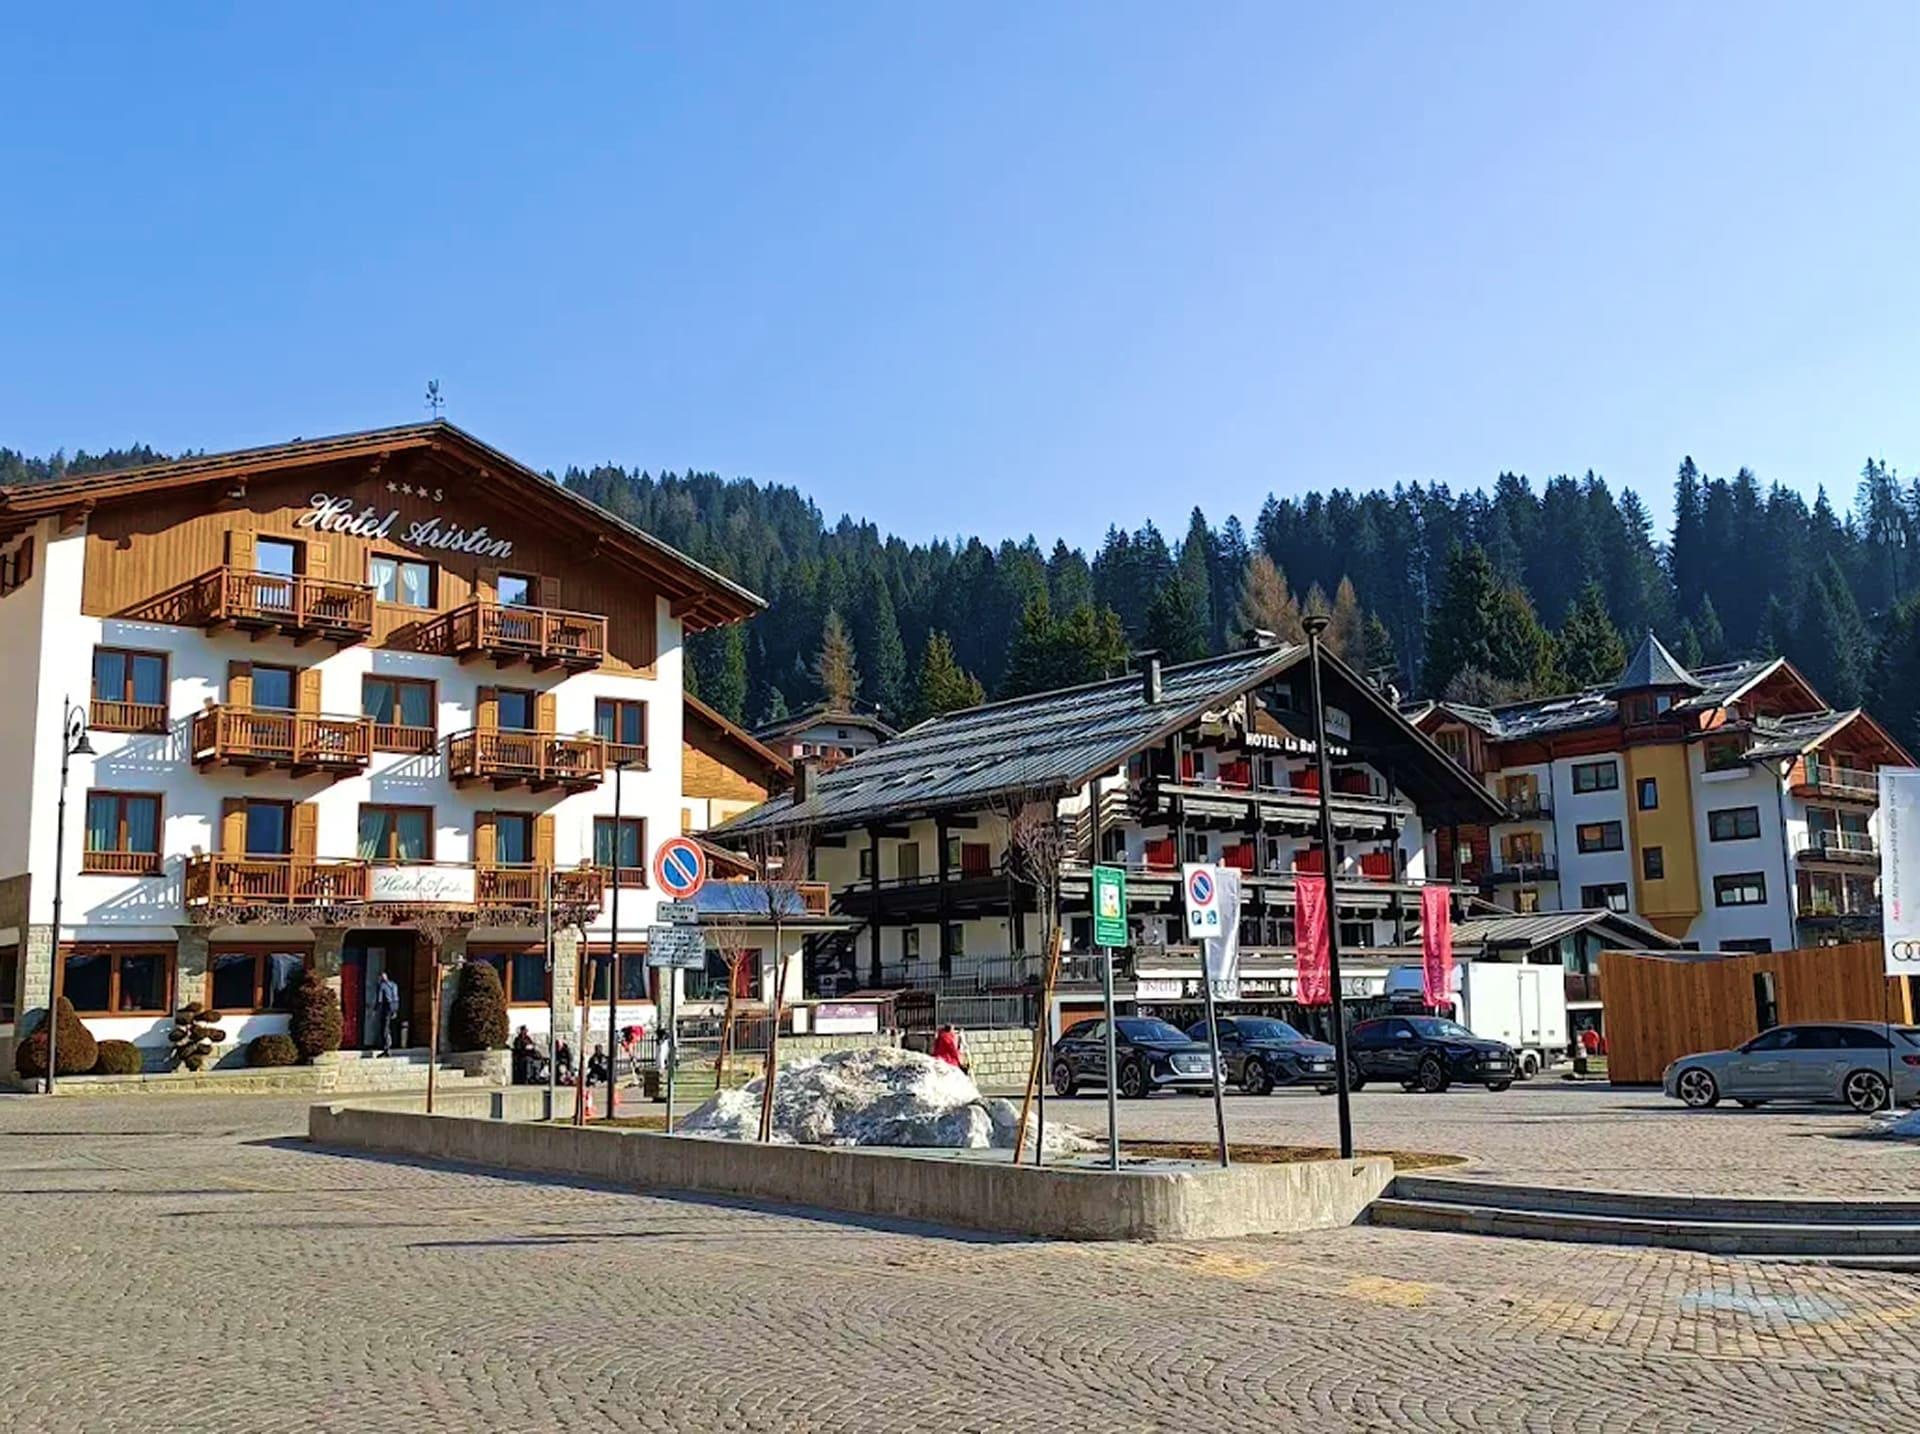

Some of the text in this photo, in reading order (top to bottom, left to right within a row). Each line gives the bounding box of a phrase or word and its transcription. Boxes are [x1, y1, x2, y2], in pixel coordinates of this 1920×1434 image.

[297, 492, 513, 559] Hotel Ariston
[1245, 732, 1281, 750] HOTEL
[1284, 737, 1298, 751] La
